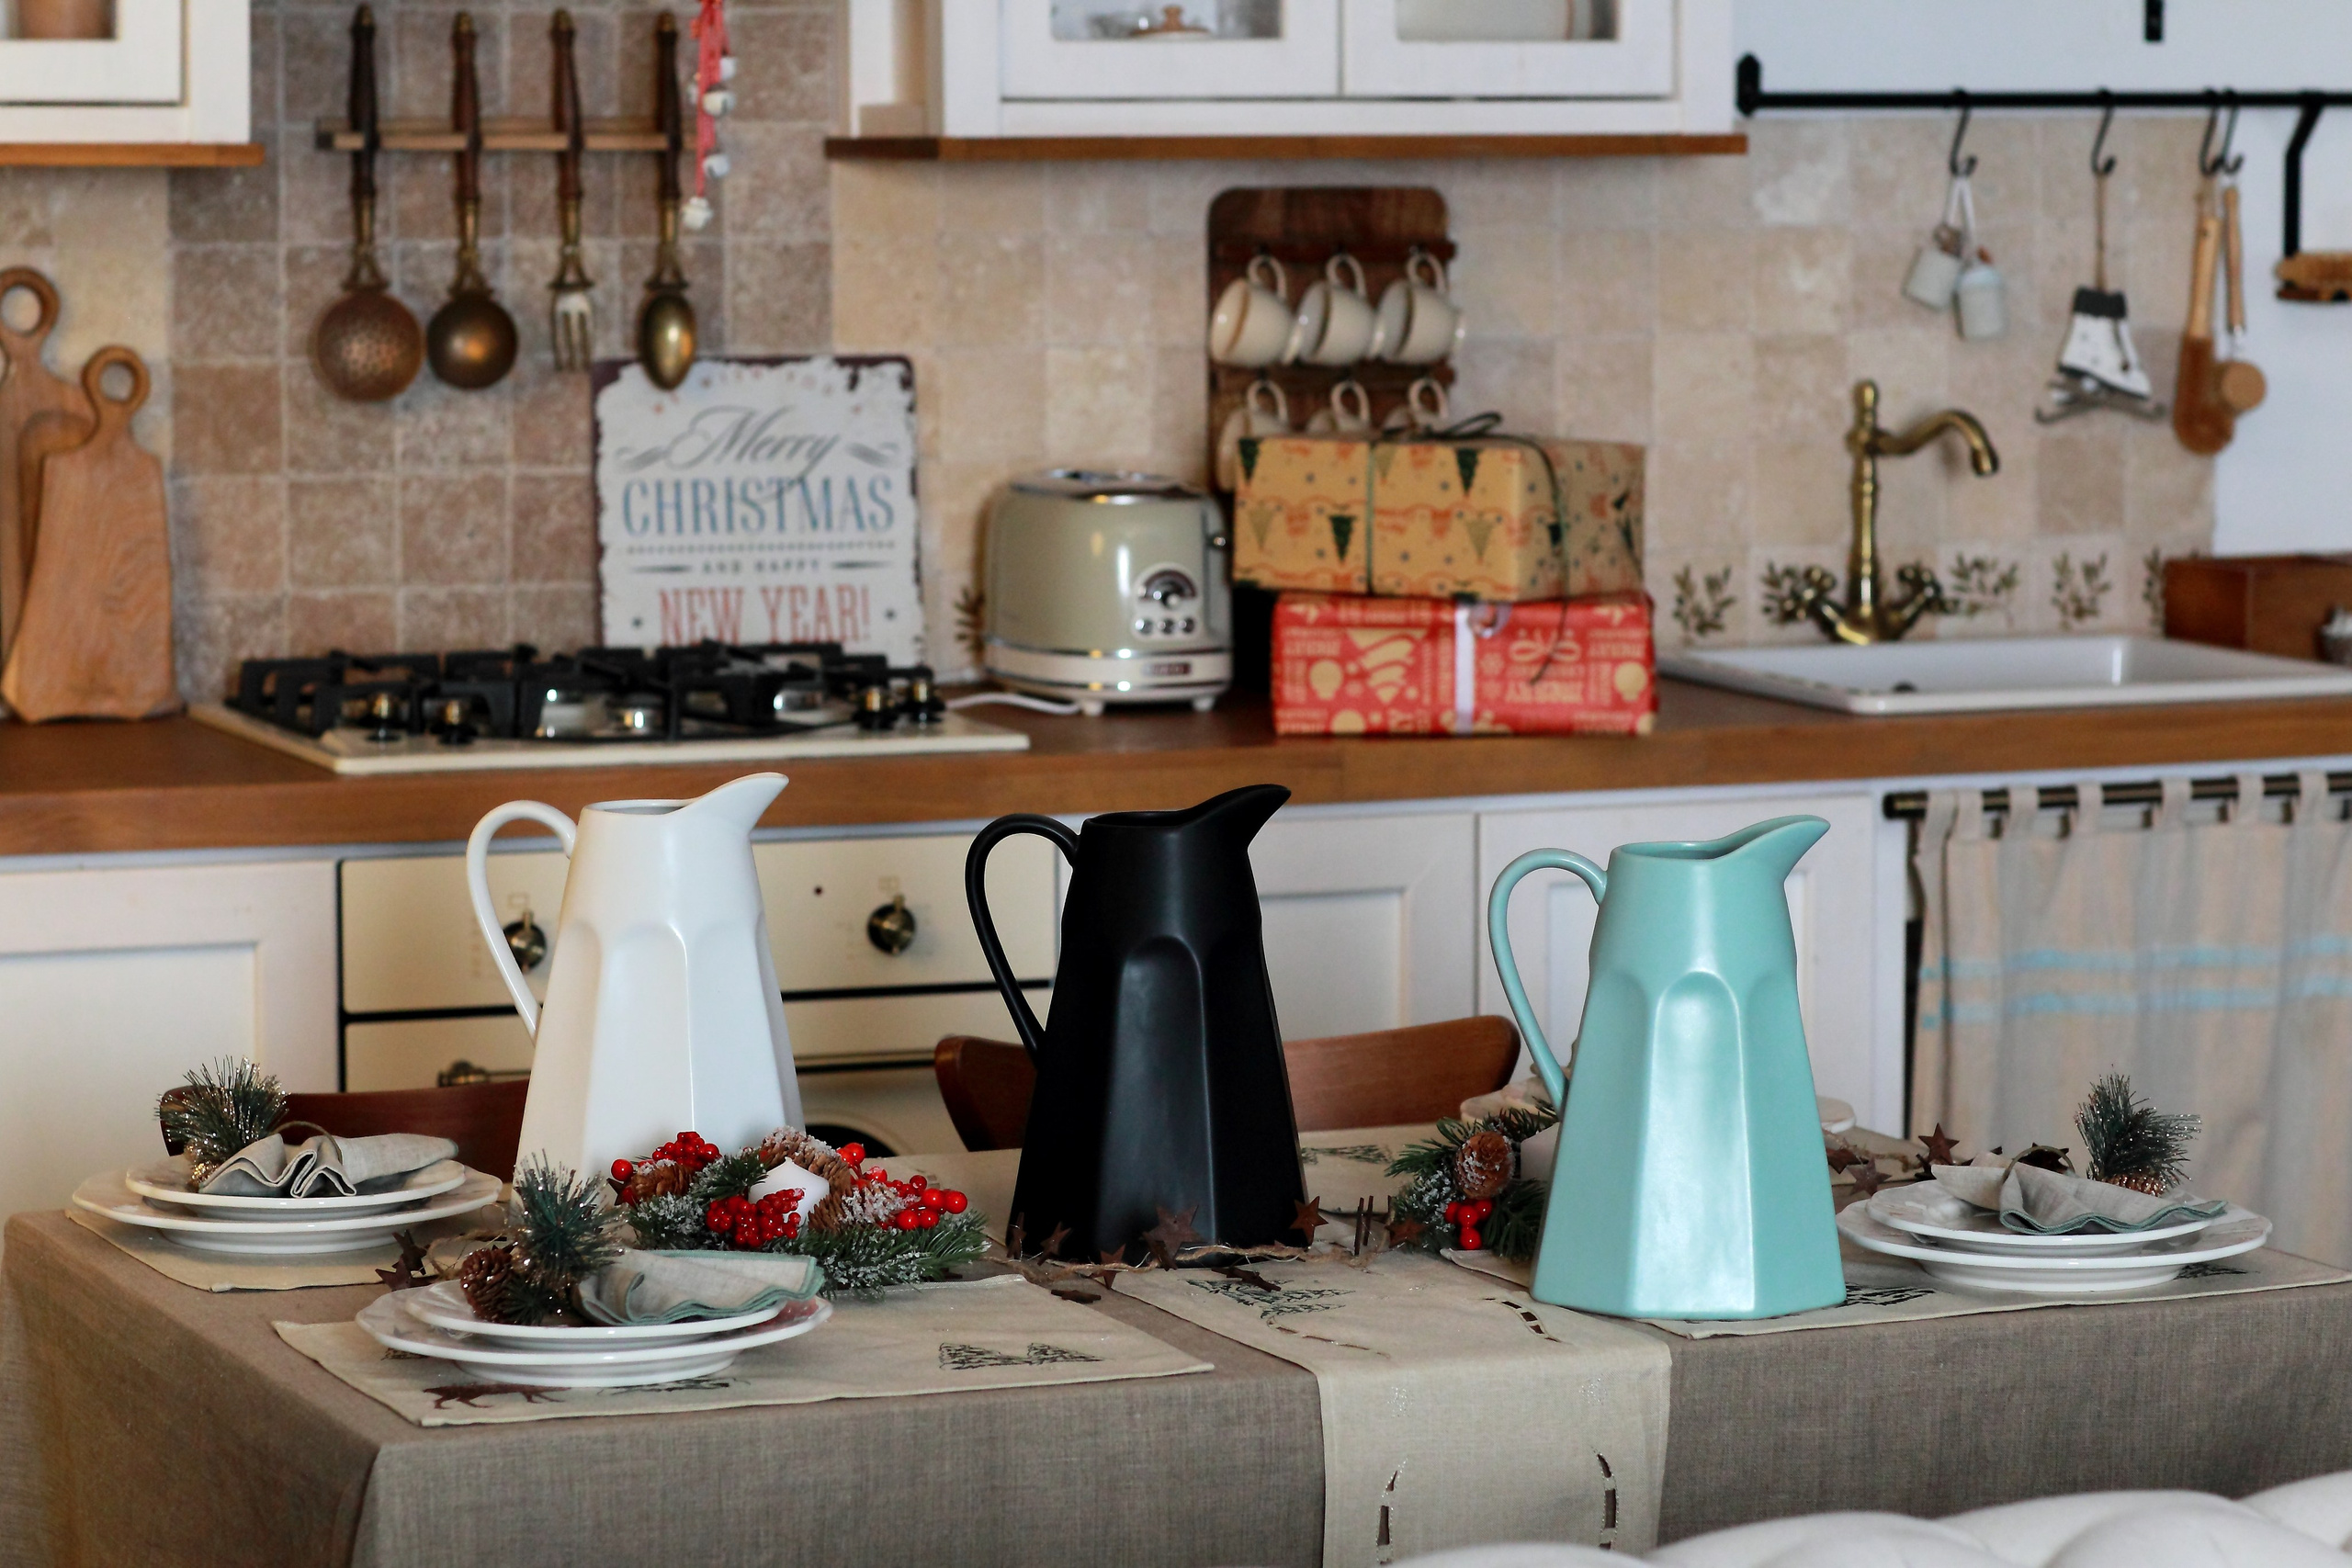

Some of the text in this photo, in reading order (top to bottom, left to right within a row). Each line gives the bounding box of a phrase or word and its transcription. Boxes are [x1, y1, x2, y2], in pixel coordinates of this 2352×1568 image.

[663, 404, 841, 502] Merry
[622, 474, 895, 537] CHRISTMAS
[658, 583, 872, 646] NEW YEAR!
